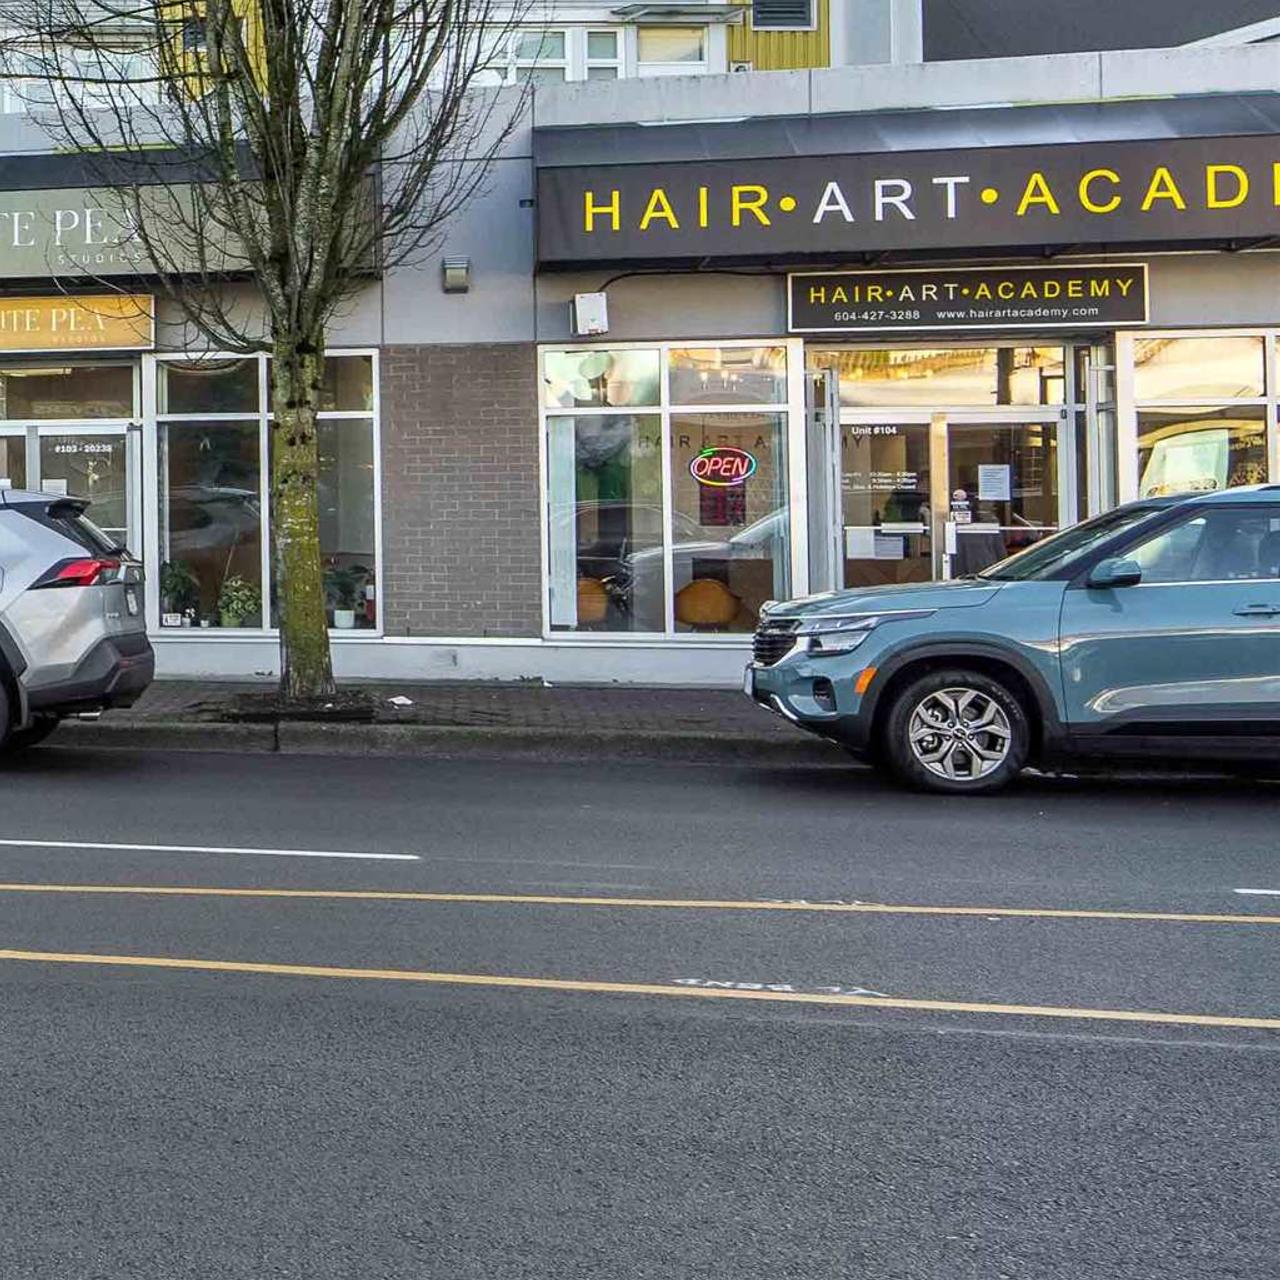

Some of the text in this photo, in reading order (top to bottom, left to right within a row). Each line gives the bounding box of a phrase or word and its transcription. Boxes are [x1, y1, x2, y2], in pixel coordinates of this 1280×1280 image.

[584, 163, 1280, 232] HAIR ART ACAD
[54, 209, 142, 247] PEA
[58, 251, 142, 264] STUDIOS
[810, 278, 1134, 304] HAIR ART ACADEMY
[51, 307, 106, 332] PEA
[834, 305, 1099, 321] 604-427-3288 www.hairartacademy.com
[851, 426, 897, 435] Unit #104
[694, 457, 749, 476] OPEN
